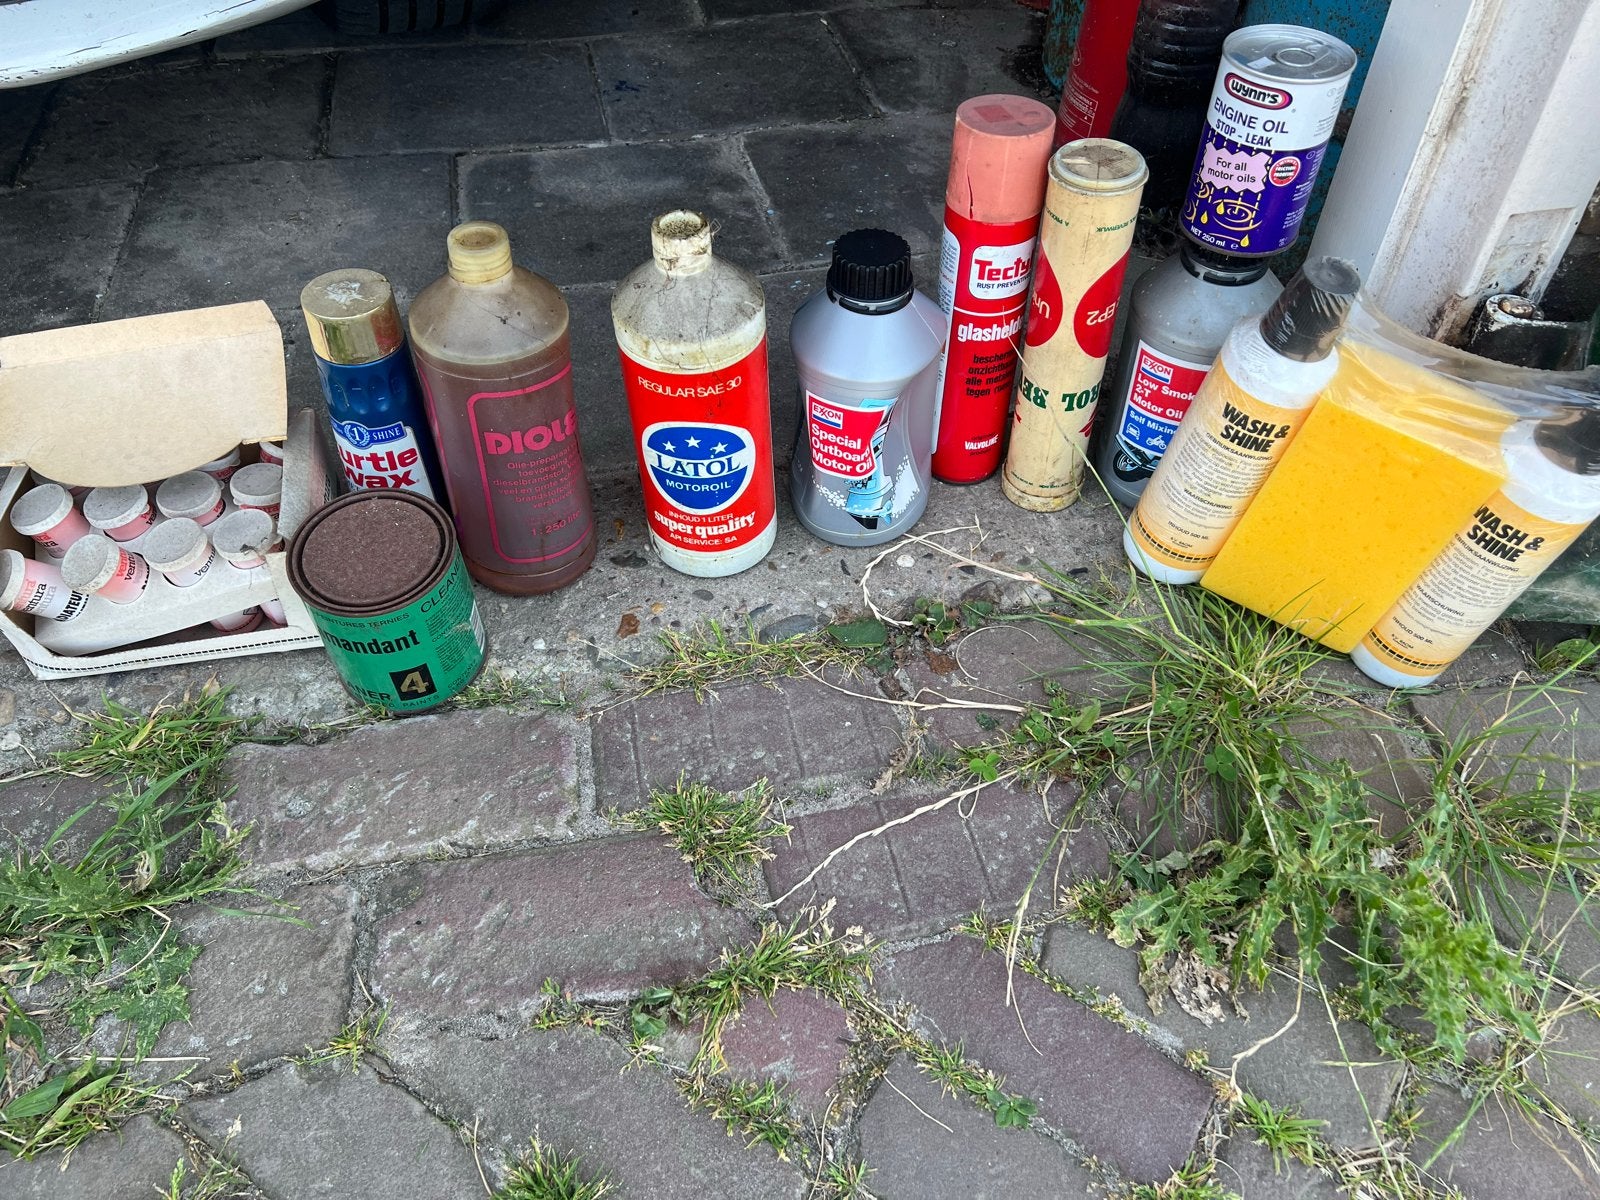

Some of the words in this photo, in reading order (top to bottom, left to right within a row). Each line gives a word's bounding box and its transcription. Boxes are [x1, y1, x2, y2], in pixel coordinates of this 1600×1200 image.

[1214, 96, 1258, 130] ENGINE
[1262, 119, 1289, 134] OIL
[1215, 118, 1236, 136] STOP
[1245, 133, 1273, 147] LEAK
[1207, 168, 1233, 182] motor
[1237, 173, 1256, 184] oils
[1216, 157, 1233, 172] For
[1234, 162, 1247, 171] all
[1190, 225, 1202, 237] NET
[1202, 233, 1215, 243] 250
[974, 257, 1031, 281] Tecty
[1142, 356, 1172, 376] EXXON
[637, 376, 695, 397] REGULAR
[697, 384, 725, 398] SAE
[726, 376, 742, 391] 30
[965, 377, 982, 386] alle
[966, 388, 990, 397] tegen
[1135, 384, 1151, 397] 2-T
[1137, 372, 1158, 390] Low
[1161, 384, 1196, 401] Smok
[813, 404, 842, 420] EXXON
[1129, 410, 1145, 425] Self
[1133, 394, 1163, 414] Motor
[1166, 408, 1183, 419] Oil
[1222, 401, 1275, 438] WASH
[1274, 424, 1291, 440] &
[372, 427, 401, 441] SHINE
[811, 423, 861, 449] Special
[1220, 424, 1275, 453] SHINE
[338, 447, 419, 472] urtle
[811, 437, 870, 462] Outboard
[812, 449, 853, 472] Motor
[855, 460, 873, 473] Oil
[656, 453, 740, 477] LATOL
[665, 479, 732, 492] MOTOROIL
[545, 519, 567, 534] 250
[654, 510, 694, 535] super
[695, 511, 756, 539] quality
[668, 511, 700, 523] INHOUD
[708, 512, 734, 523] LITER
[1168, 520, 1190, 536] INHOUD
[1473, 504, 1529, 545] WASH
[1525, 536, 1545, 552] &
[669, 532, 682, 542] API
[683, 537, 723, 546] SERVICE:
[1467, 524, 1525, 563] SHINE
[22, 583, 47, 613] entura
[401, 671, 429, 694] 4
